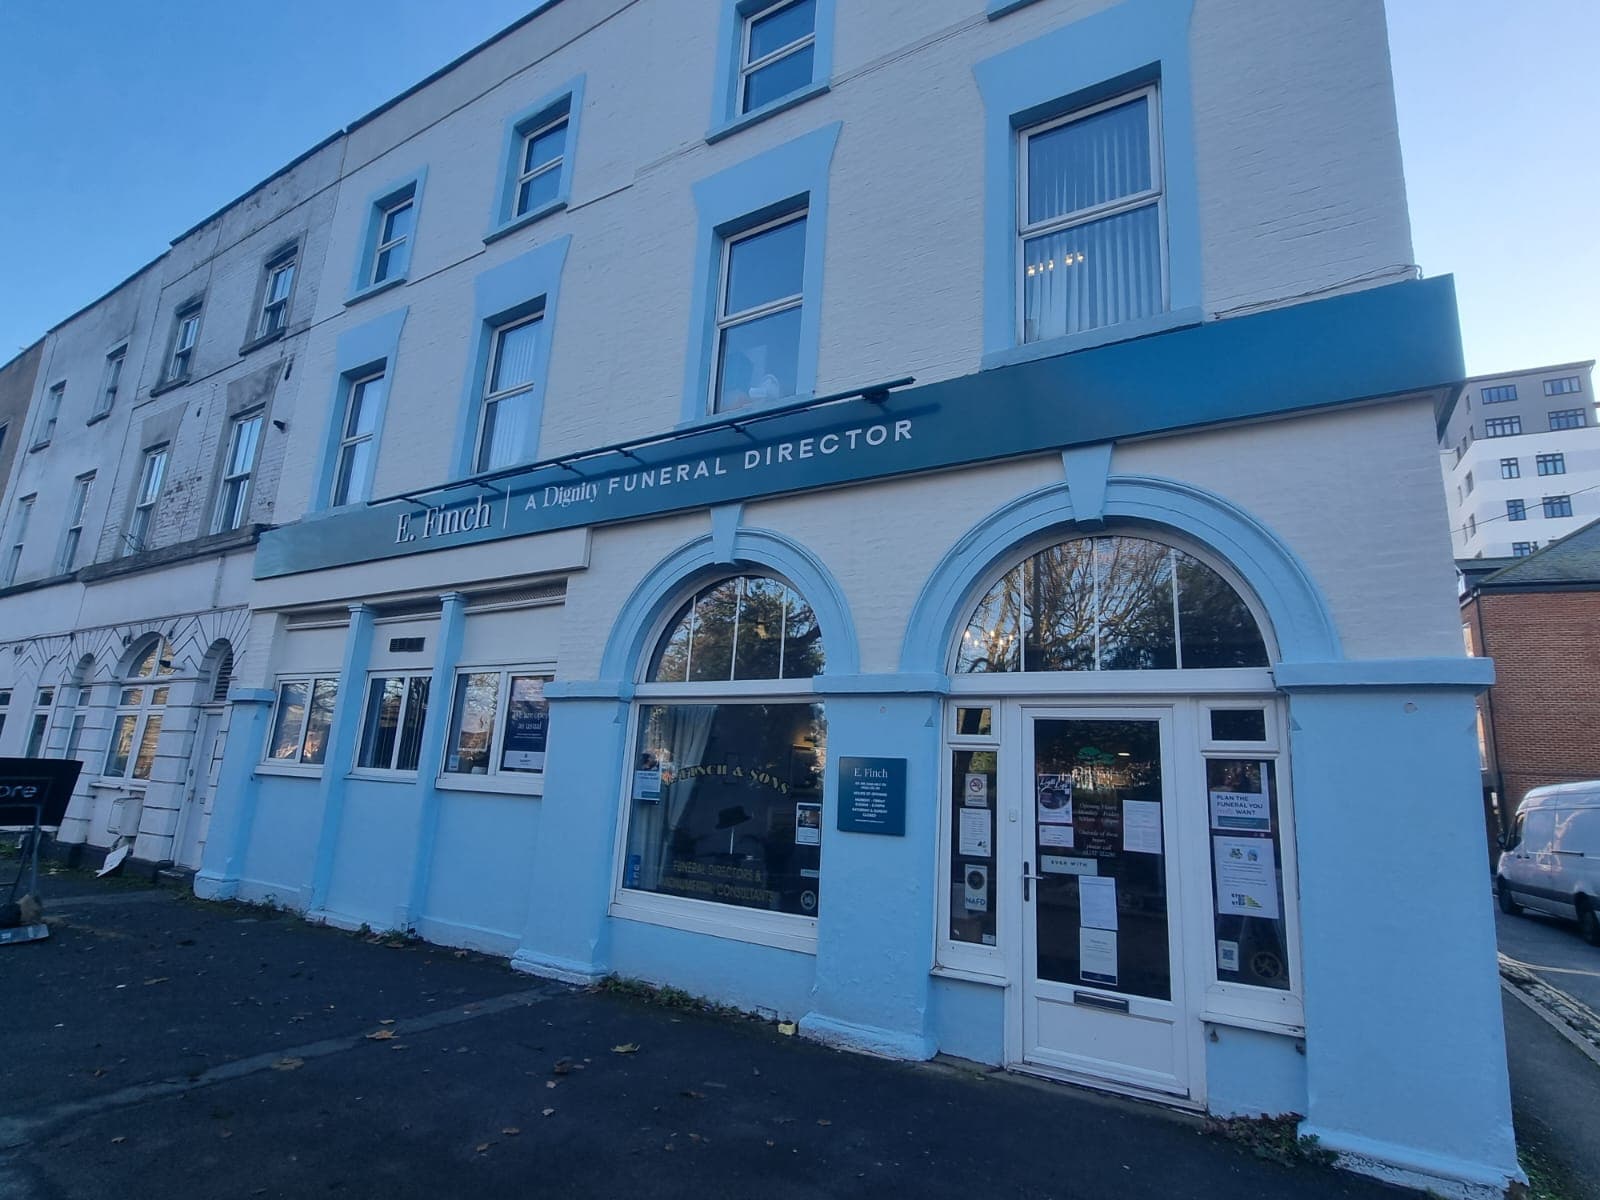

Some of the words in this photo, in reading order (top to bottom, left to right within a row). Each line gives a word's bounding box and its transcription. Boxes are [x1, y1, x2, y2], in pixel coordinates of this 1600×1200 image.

[524, 494, 537, 511] A
[542, 482, 600, 507] Dignity
[608, 457, 728, 495] FUNERAL
[744, 418, 913, 470] DIRECTOR
[394, 512, 416, 543] E.
[421, 495, 491, 539] Finch
[748, 769, 790, 794] SONS
[864, 768, 888, 779] Finch
